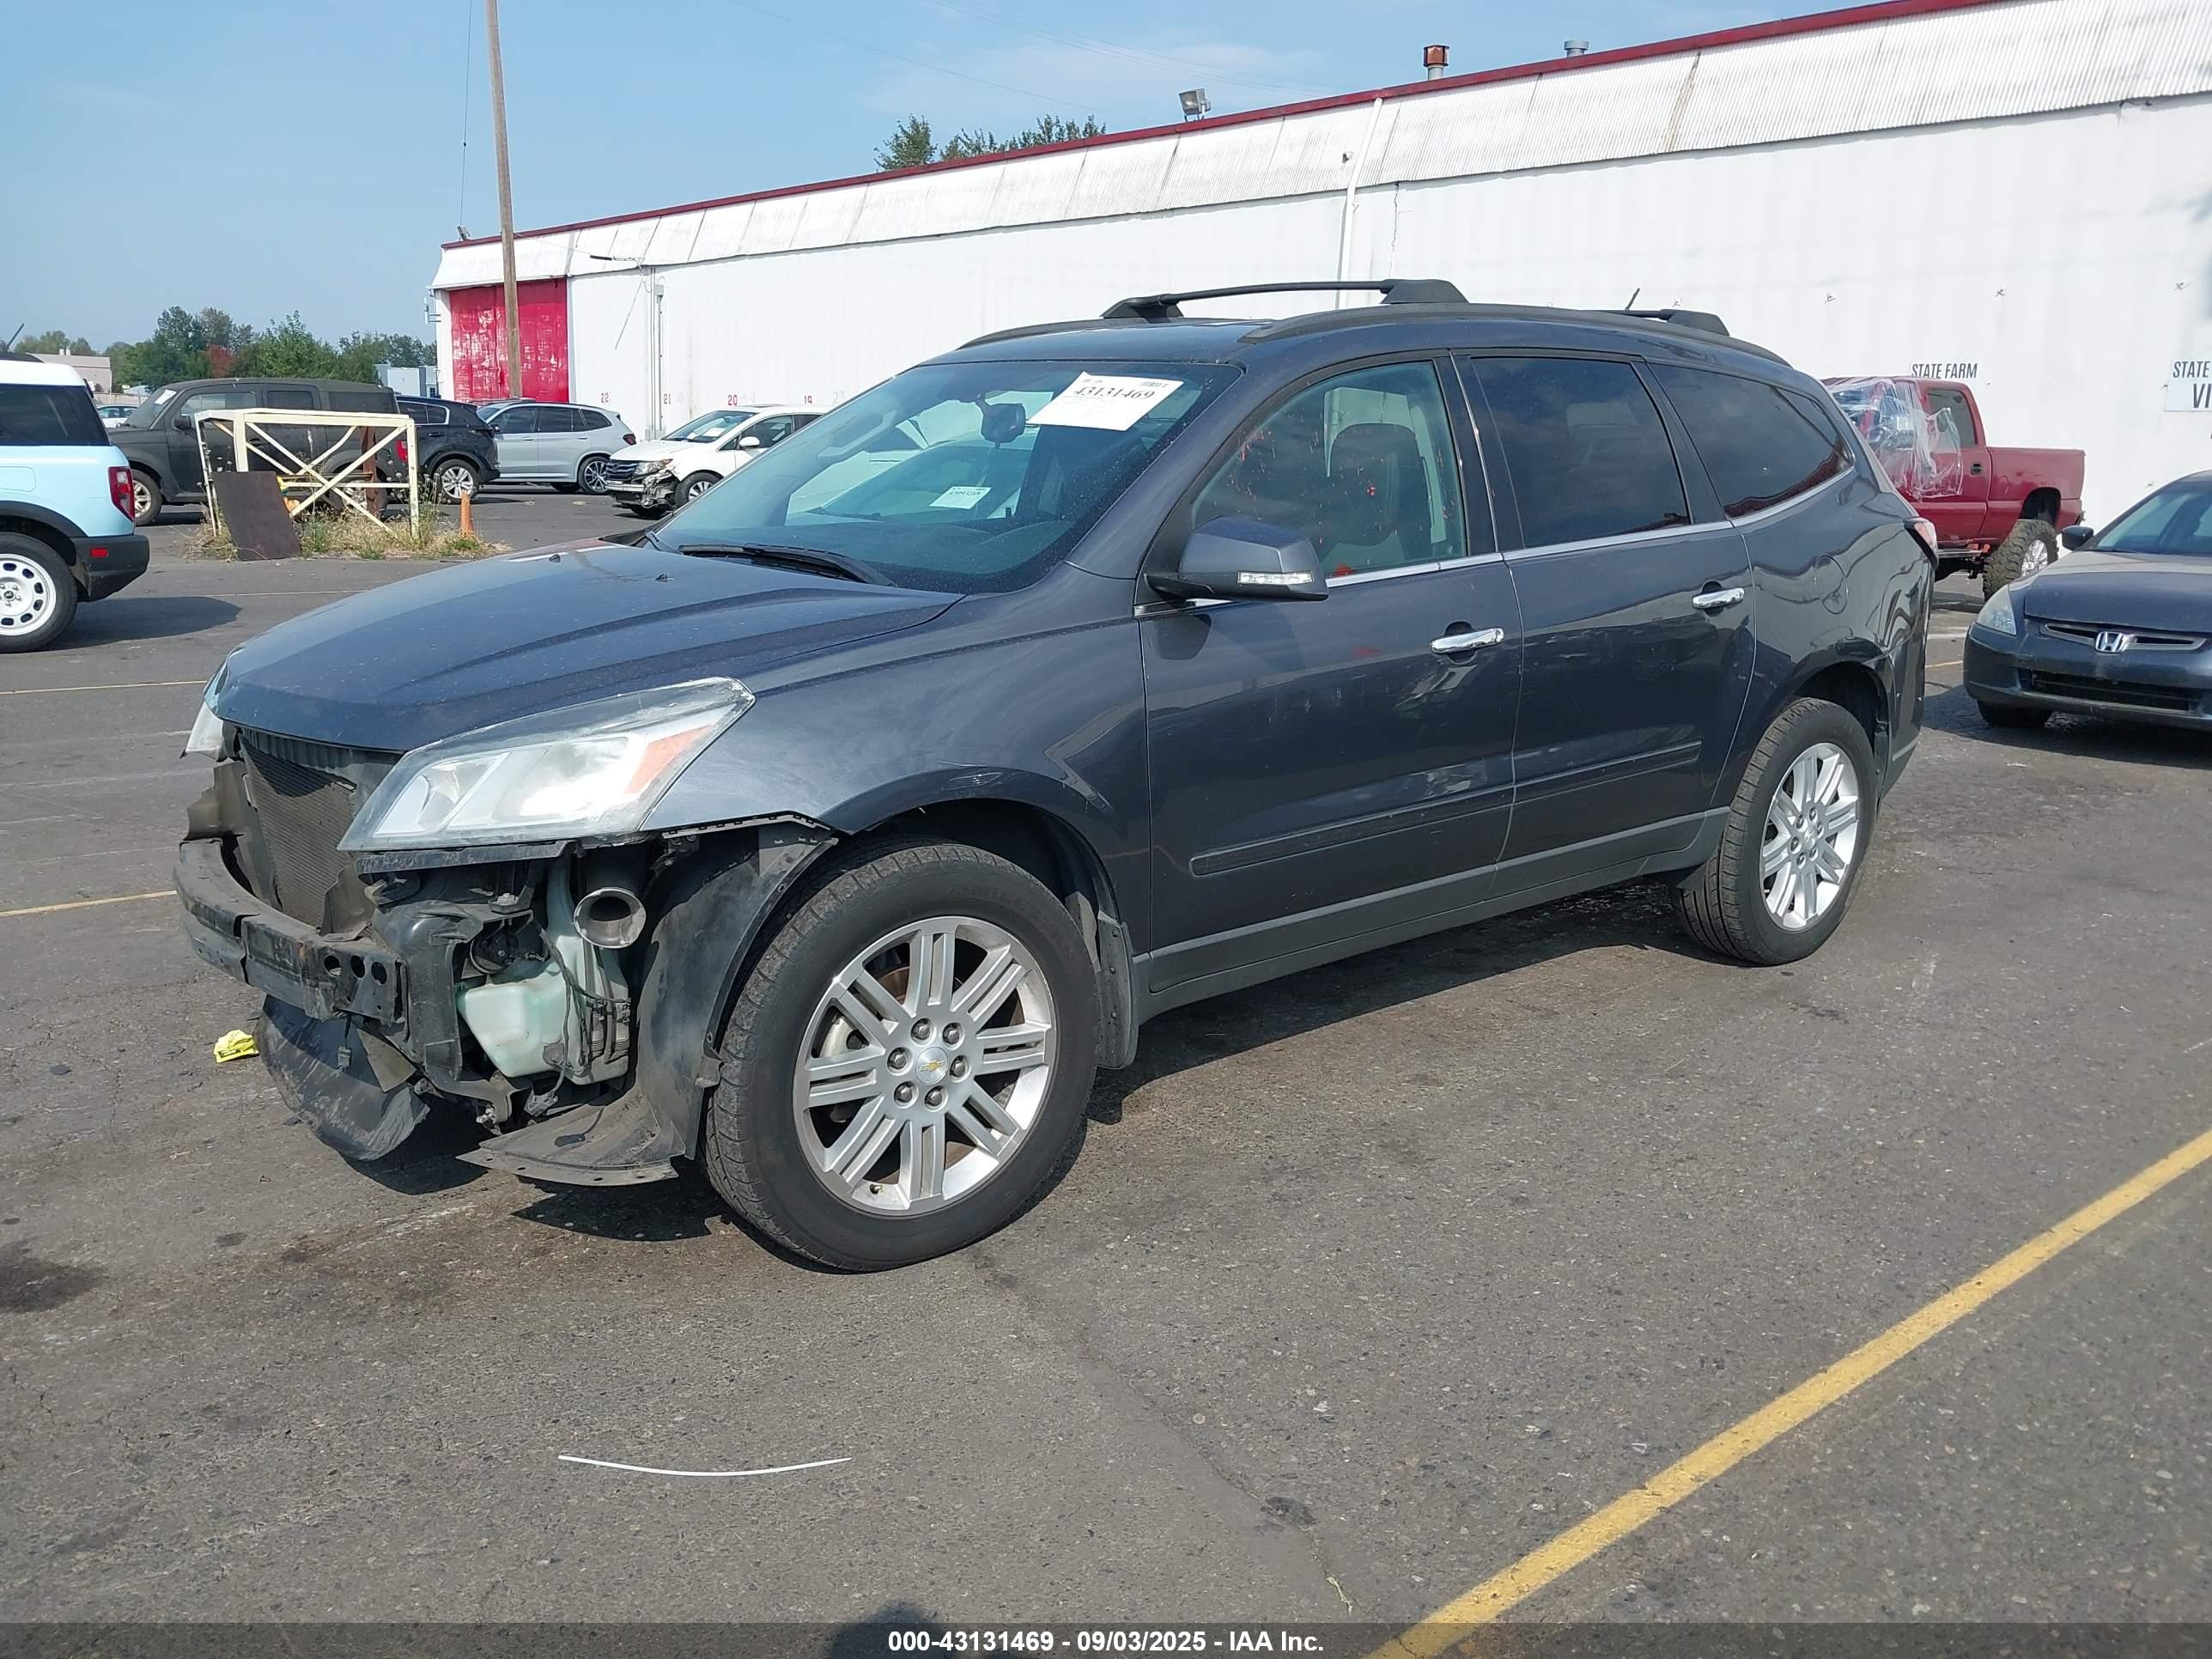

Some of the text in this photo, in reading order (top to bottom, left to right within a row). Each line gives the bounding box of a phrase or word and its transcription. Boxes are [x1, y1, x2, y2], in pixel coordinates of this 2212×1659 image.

[1911, 362, 1978, 379] STATE FARM
[2172, 361, 2211, 379] STATE
[663, 393, 672, 404] 21
[1074, 386, 1155, 399] 43131469
[727, 394, 738, 406] 20
